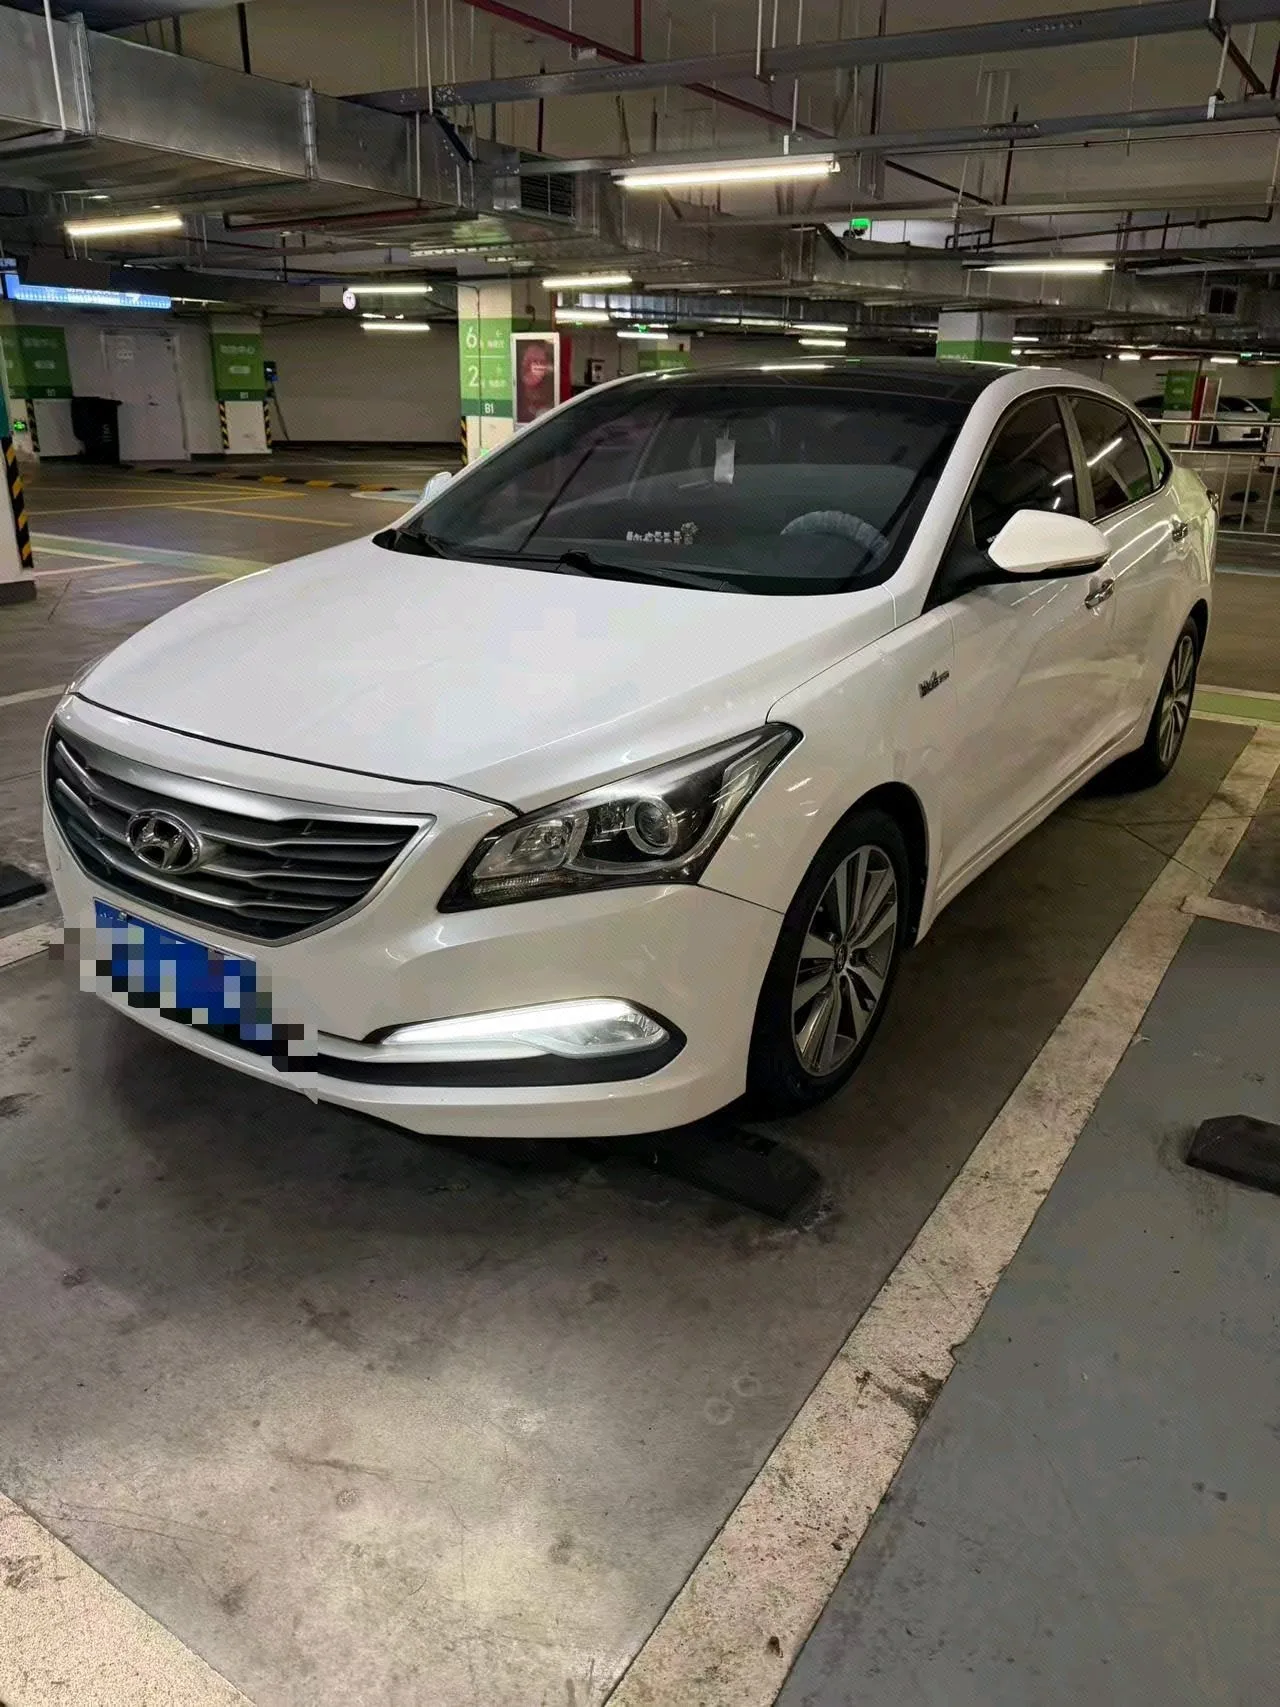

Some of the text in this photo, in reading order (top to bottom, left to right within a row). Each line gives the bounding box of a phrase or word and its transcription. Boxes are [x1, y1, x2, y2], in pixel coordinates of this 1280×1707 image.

[466, 326, 478, 348] 6
[468, 365, 479, 387] 2
[484, 403, 494, 414] B1
